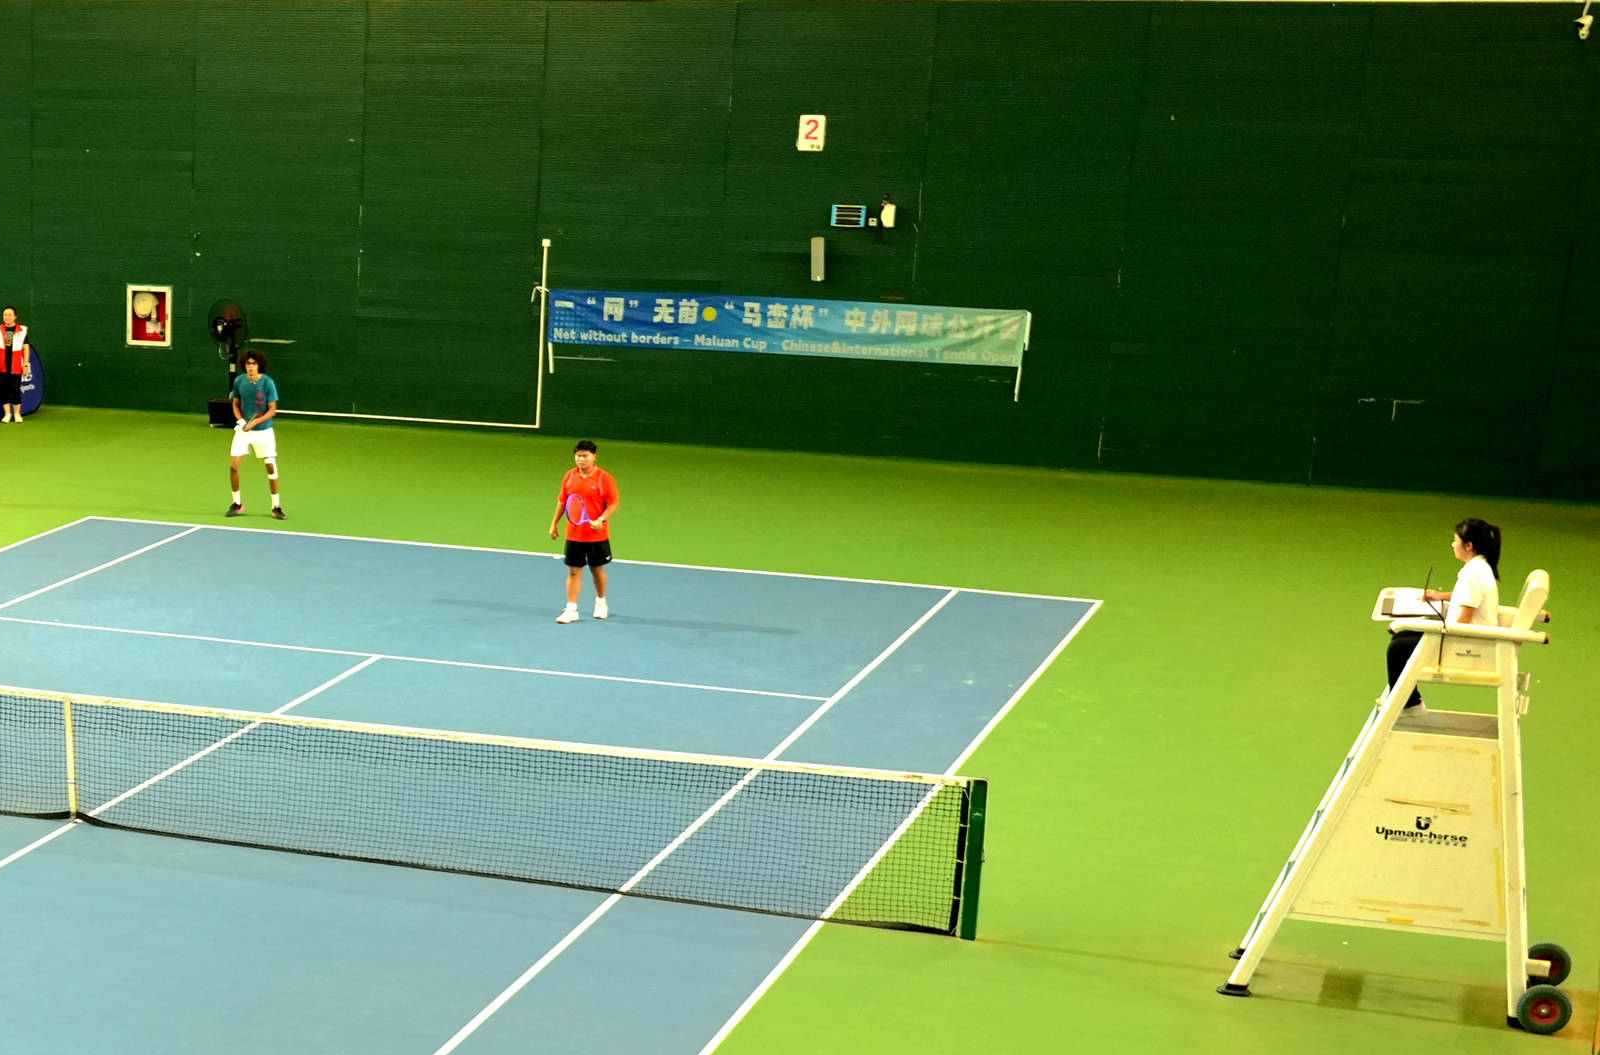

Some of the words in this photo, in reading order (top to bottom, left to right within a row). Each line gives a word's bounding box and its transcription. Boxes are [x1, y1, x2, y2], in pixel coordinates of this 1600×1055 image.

[804, 119, 820, 141] 2
[553, 327, 577, 340] Net
[580, 329, 628, 343] without
[631, 332, 681, 345] borders
[694, 334, 740, 348] Maluan
[743, 337, 768, 352] Cup
